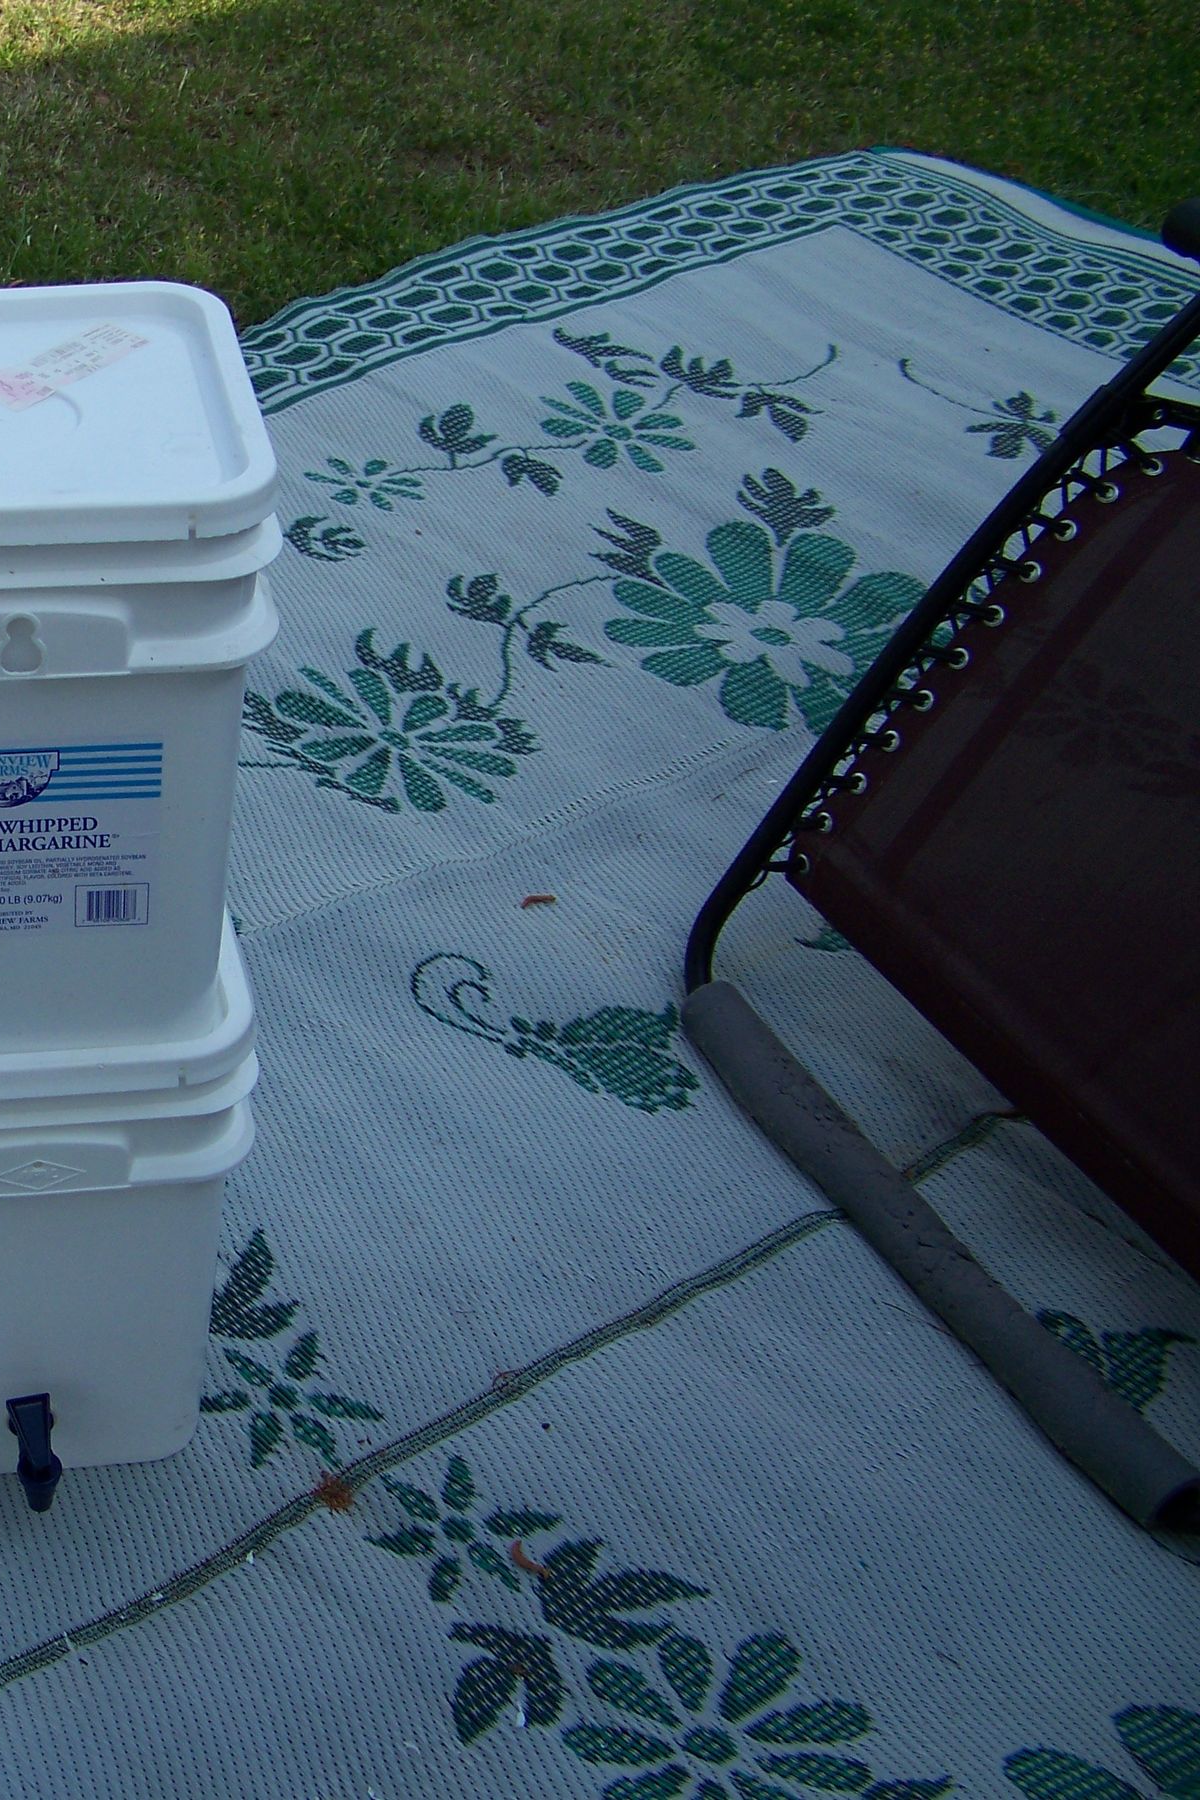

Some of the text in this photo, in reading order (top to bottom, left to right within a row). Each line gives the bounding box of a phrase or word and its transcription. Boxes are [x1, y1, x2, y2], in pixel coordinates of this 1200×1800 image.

[7, 894, 21, 905] LB
[23, 893, 63, 905] (9.07kg)
[18, 915, 49, 924] FARMS
